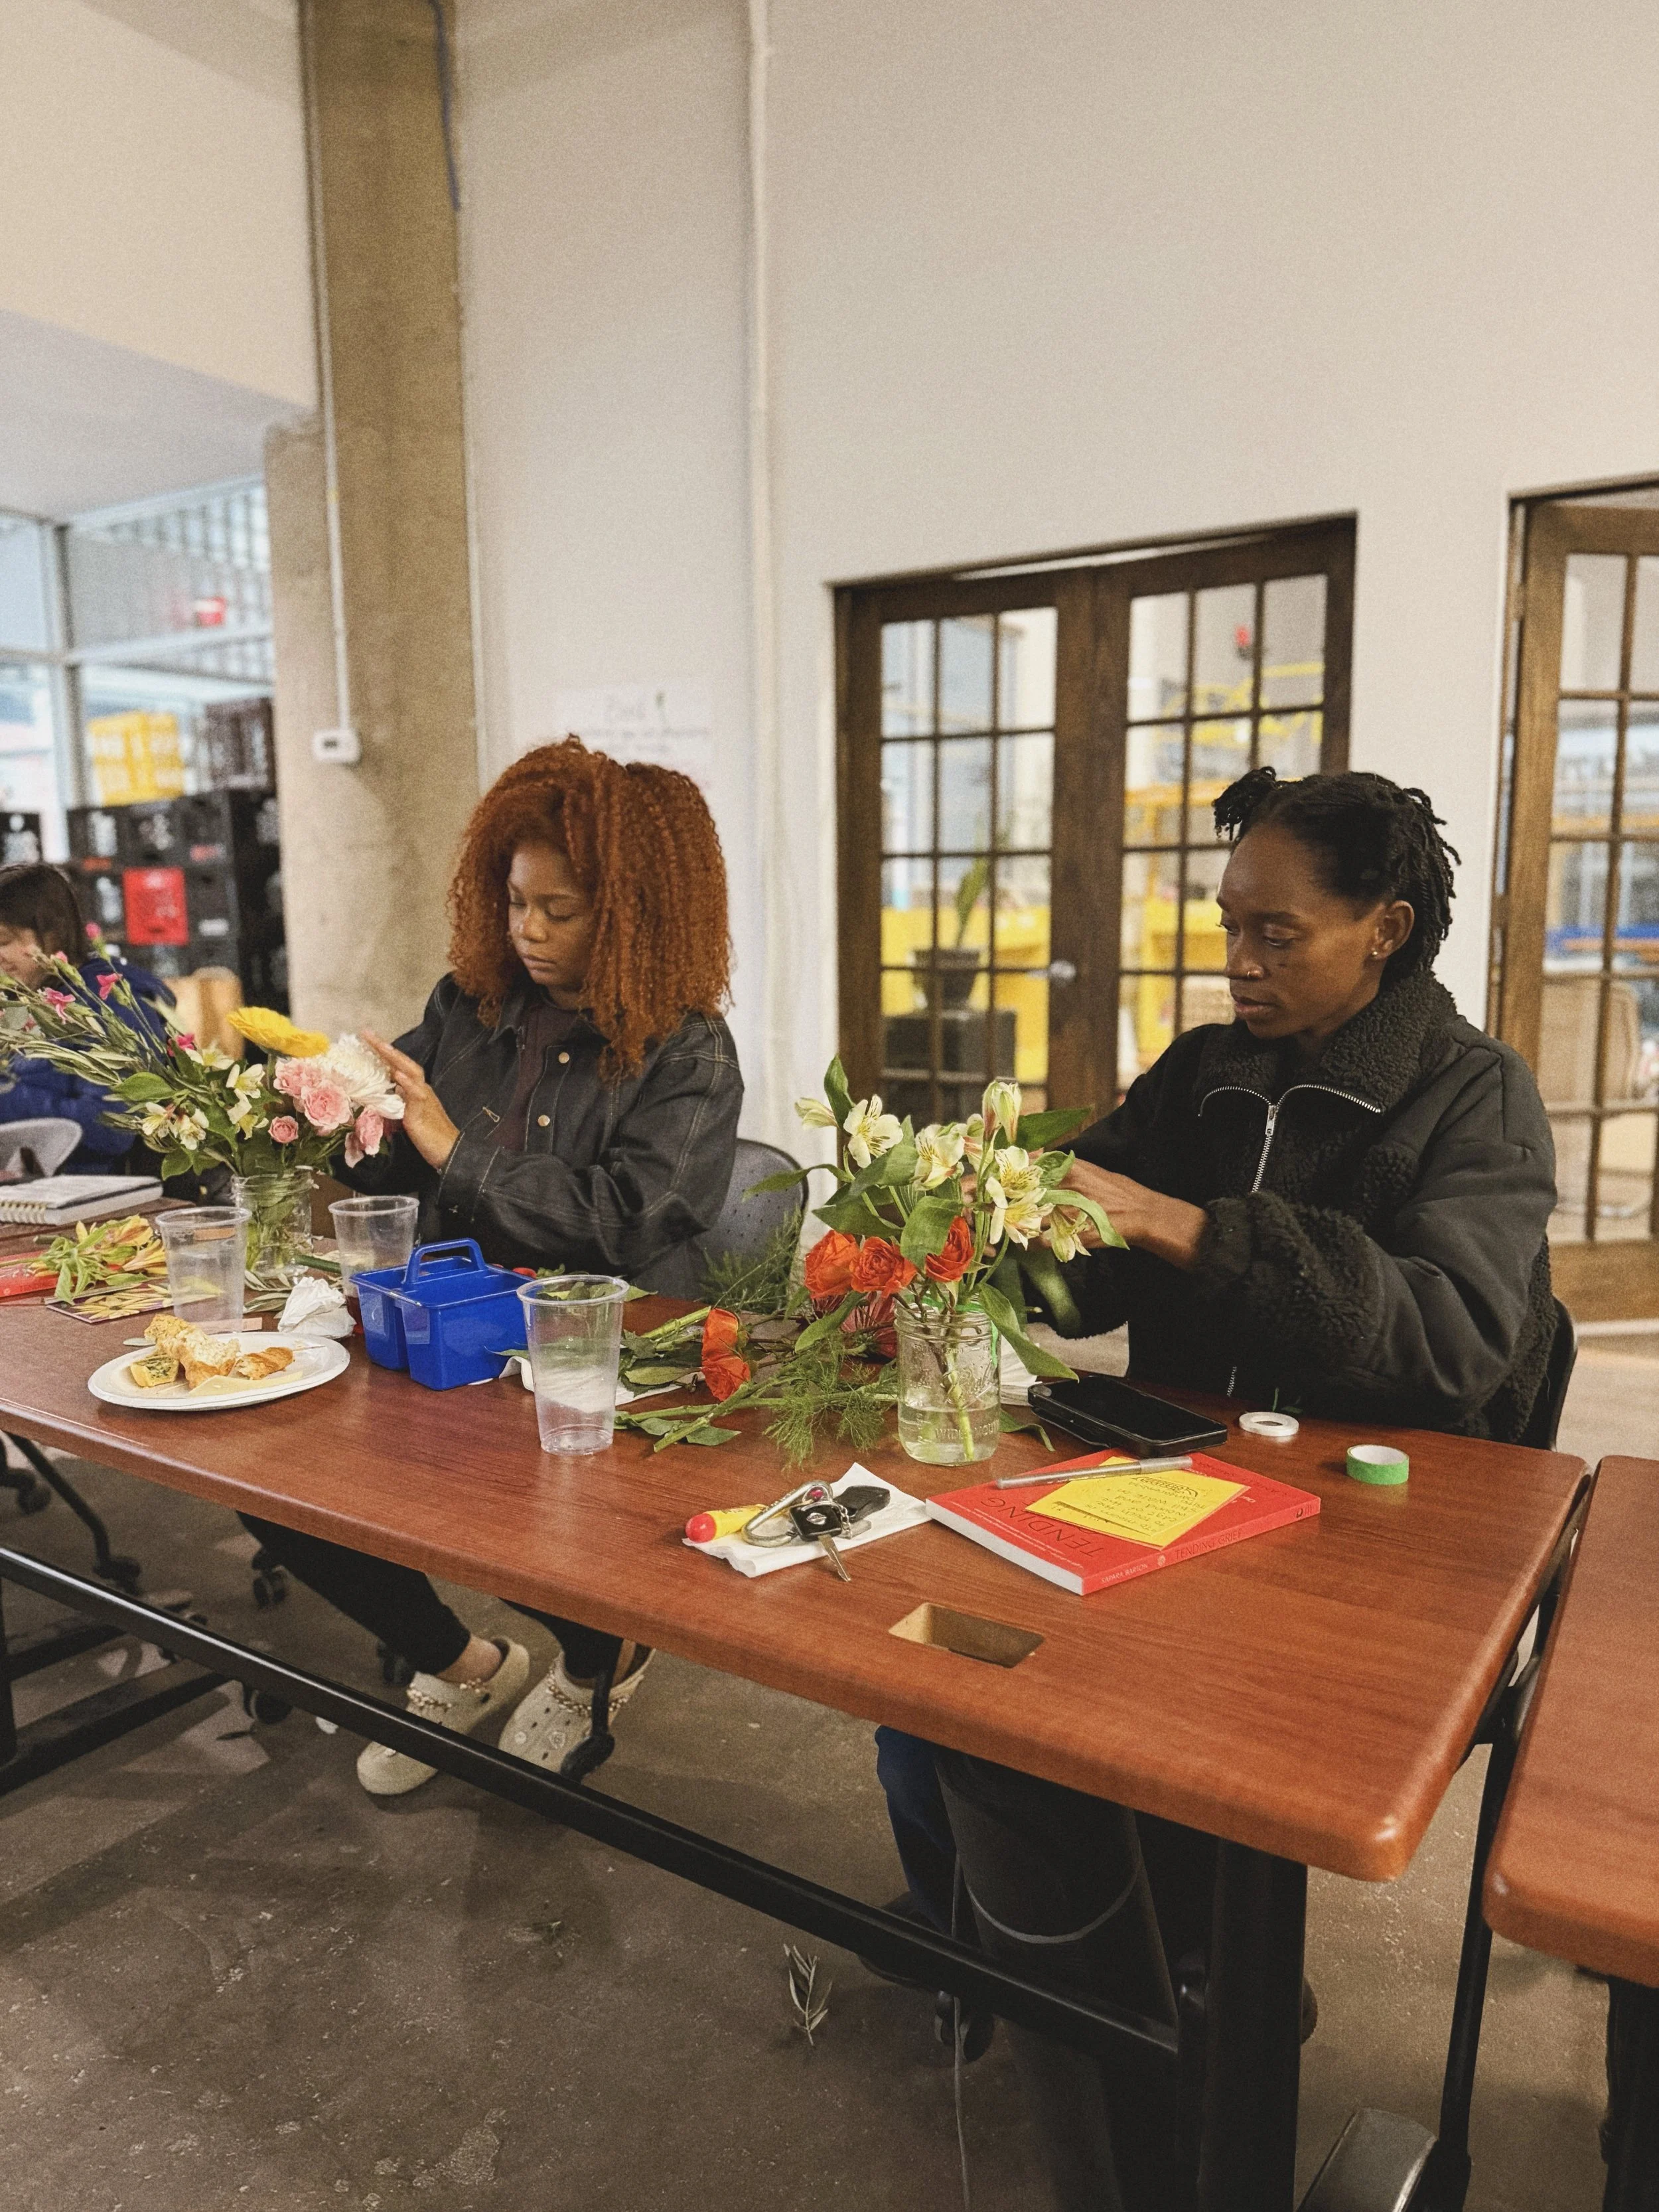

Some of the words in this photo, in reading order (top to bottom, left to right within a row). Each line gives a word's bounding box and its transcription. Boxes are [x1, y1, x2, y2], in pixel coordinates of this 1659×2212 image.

[978, 1496, 1104, 1556] TENDING
[1175, 1539, 1214, 1559] TENDING
[1217, 1529, 1242, 1546] GRIEF
